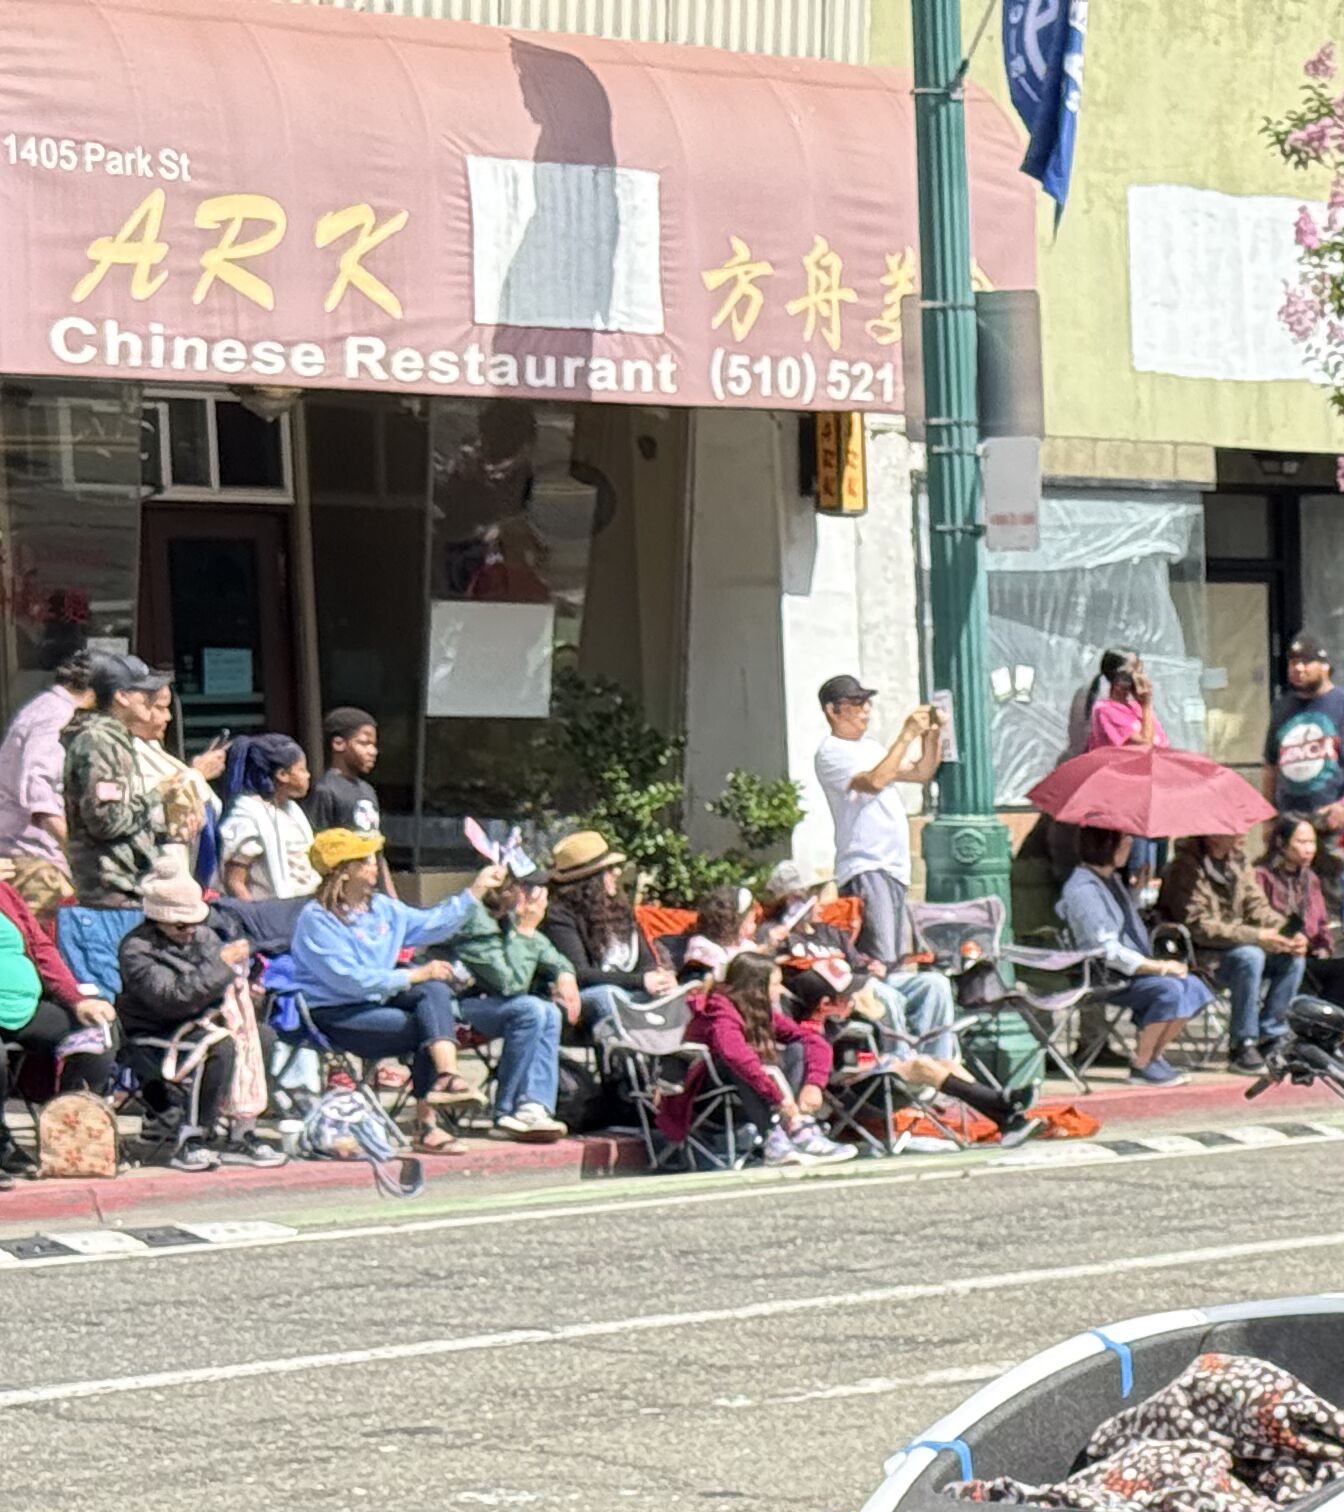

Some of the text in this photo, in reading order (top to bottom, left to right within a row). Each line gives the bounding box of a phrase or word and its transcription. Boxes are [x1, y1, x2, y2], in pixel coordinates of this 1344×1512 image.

[2, 133, 192, 182] 1405 Park St
[71, 188, 410, 320] ARK
[49, 316, 894, 405] Chinese Restaurant (510) 521
